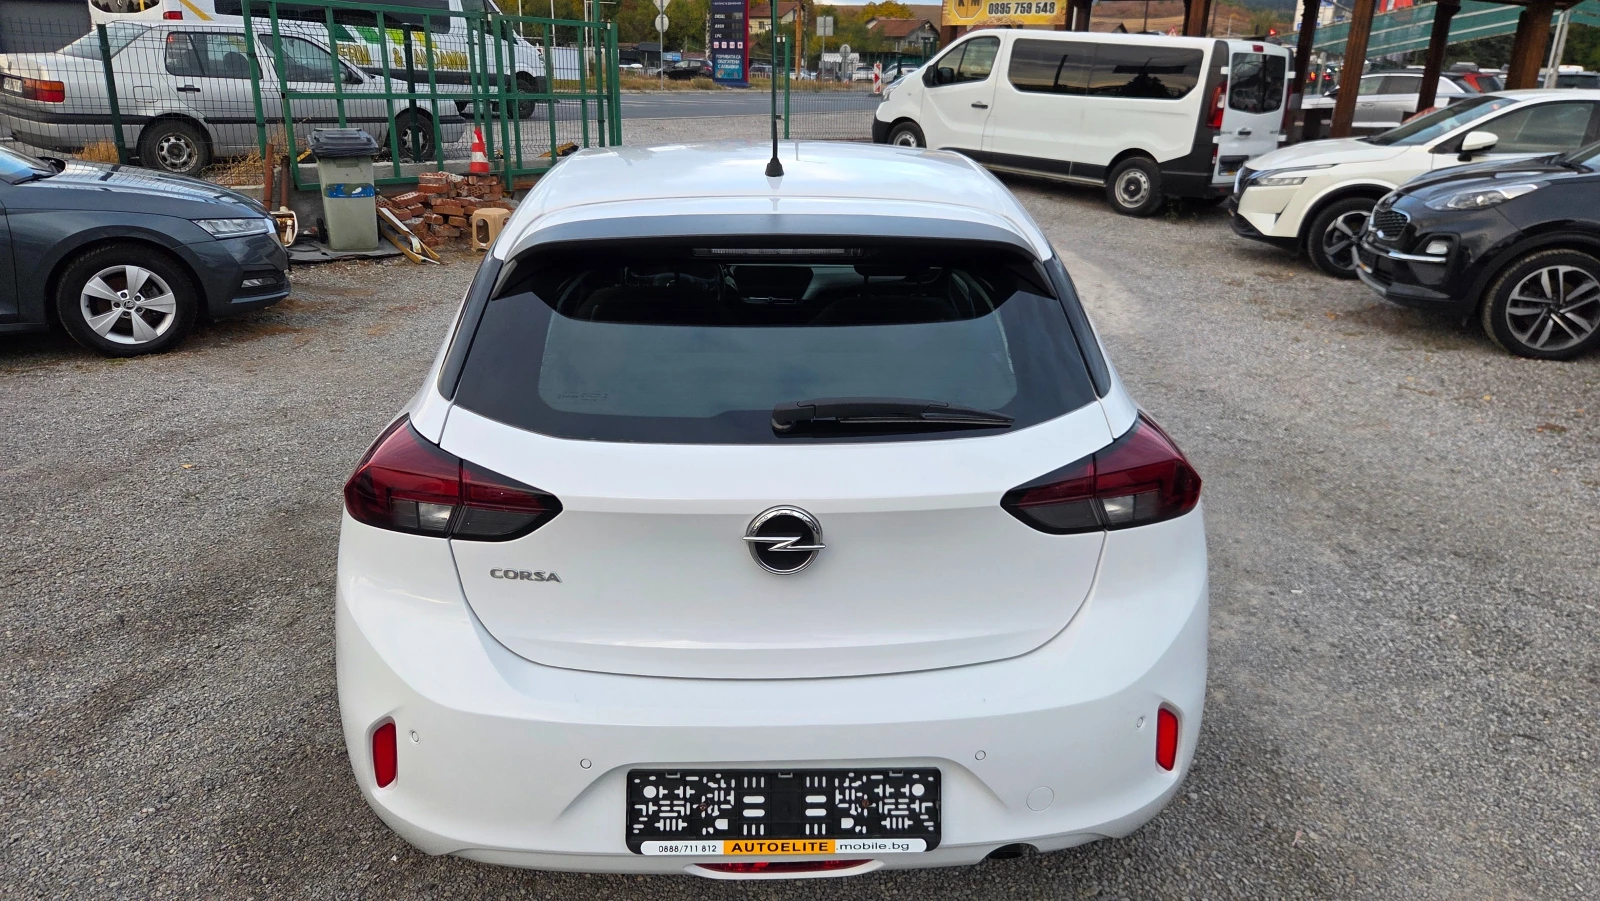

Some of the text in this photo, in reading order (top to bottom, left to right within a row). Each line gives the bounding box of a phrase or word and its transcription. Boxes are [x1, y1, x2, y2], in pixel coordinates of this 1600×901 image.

[988, 2, 1012, 14] 0895
[1035, 2, 1056, 14] 548
[489, 567, 562, 583] CORSA
[658, 844, 698, 853] 0888/711
[701, 844, 717, 853] 812
[731, 842, 829, 853] AUTOELITE
